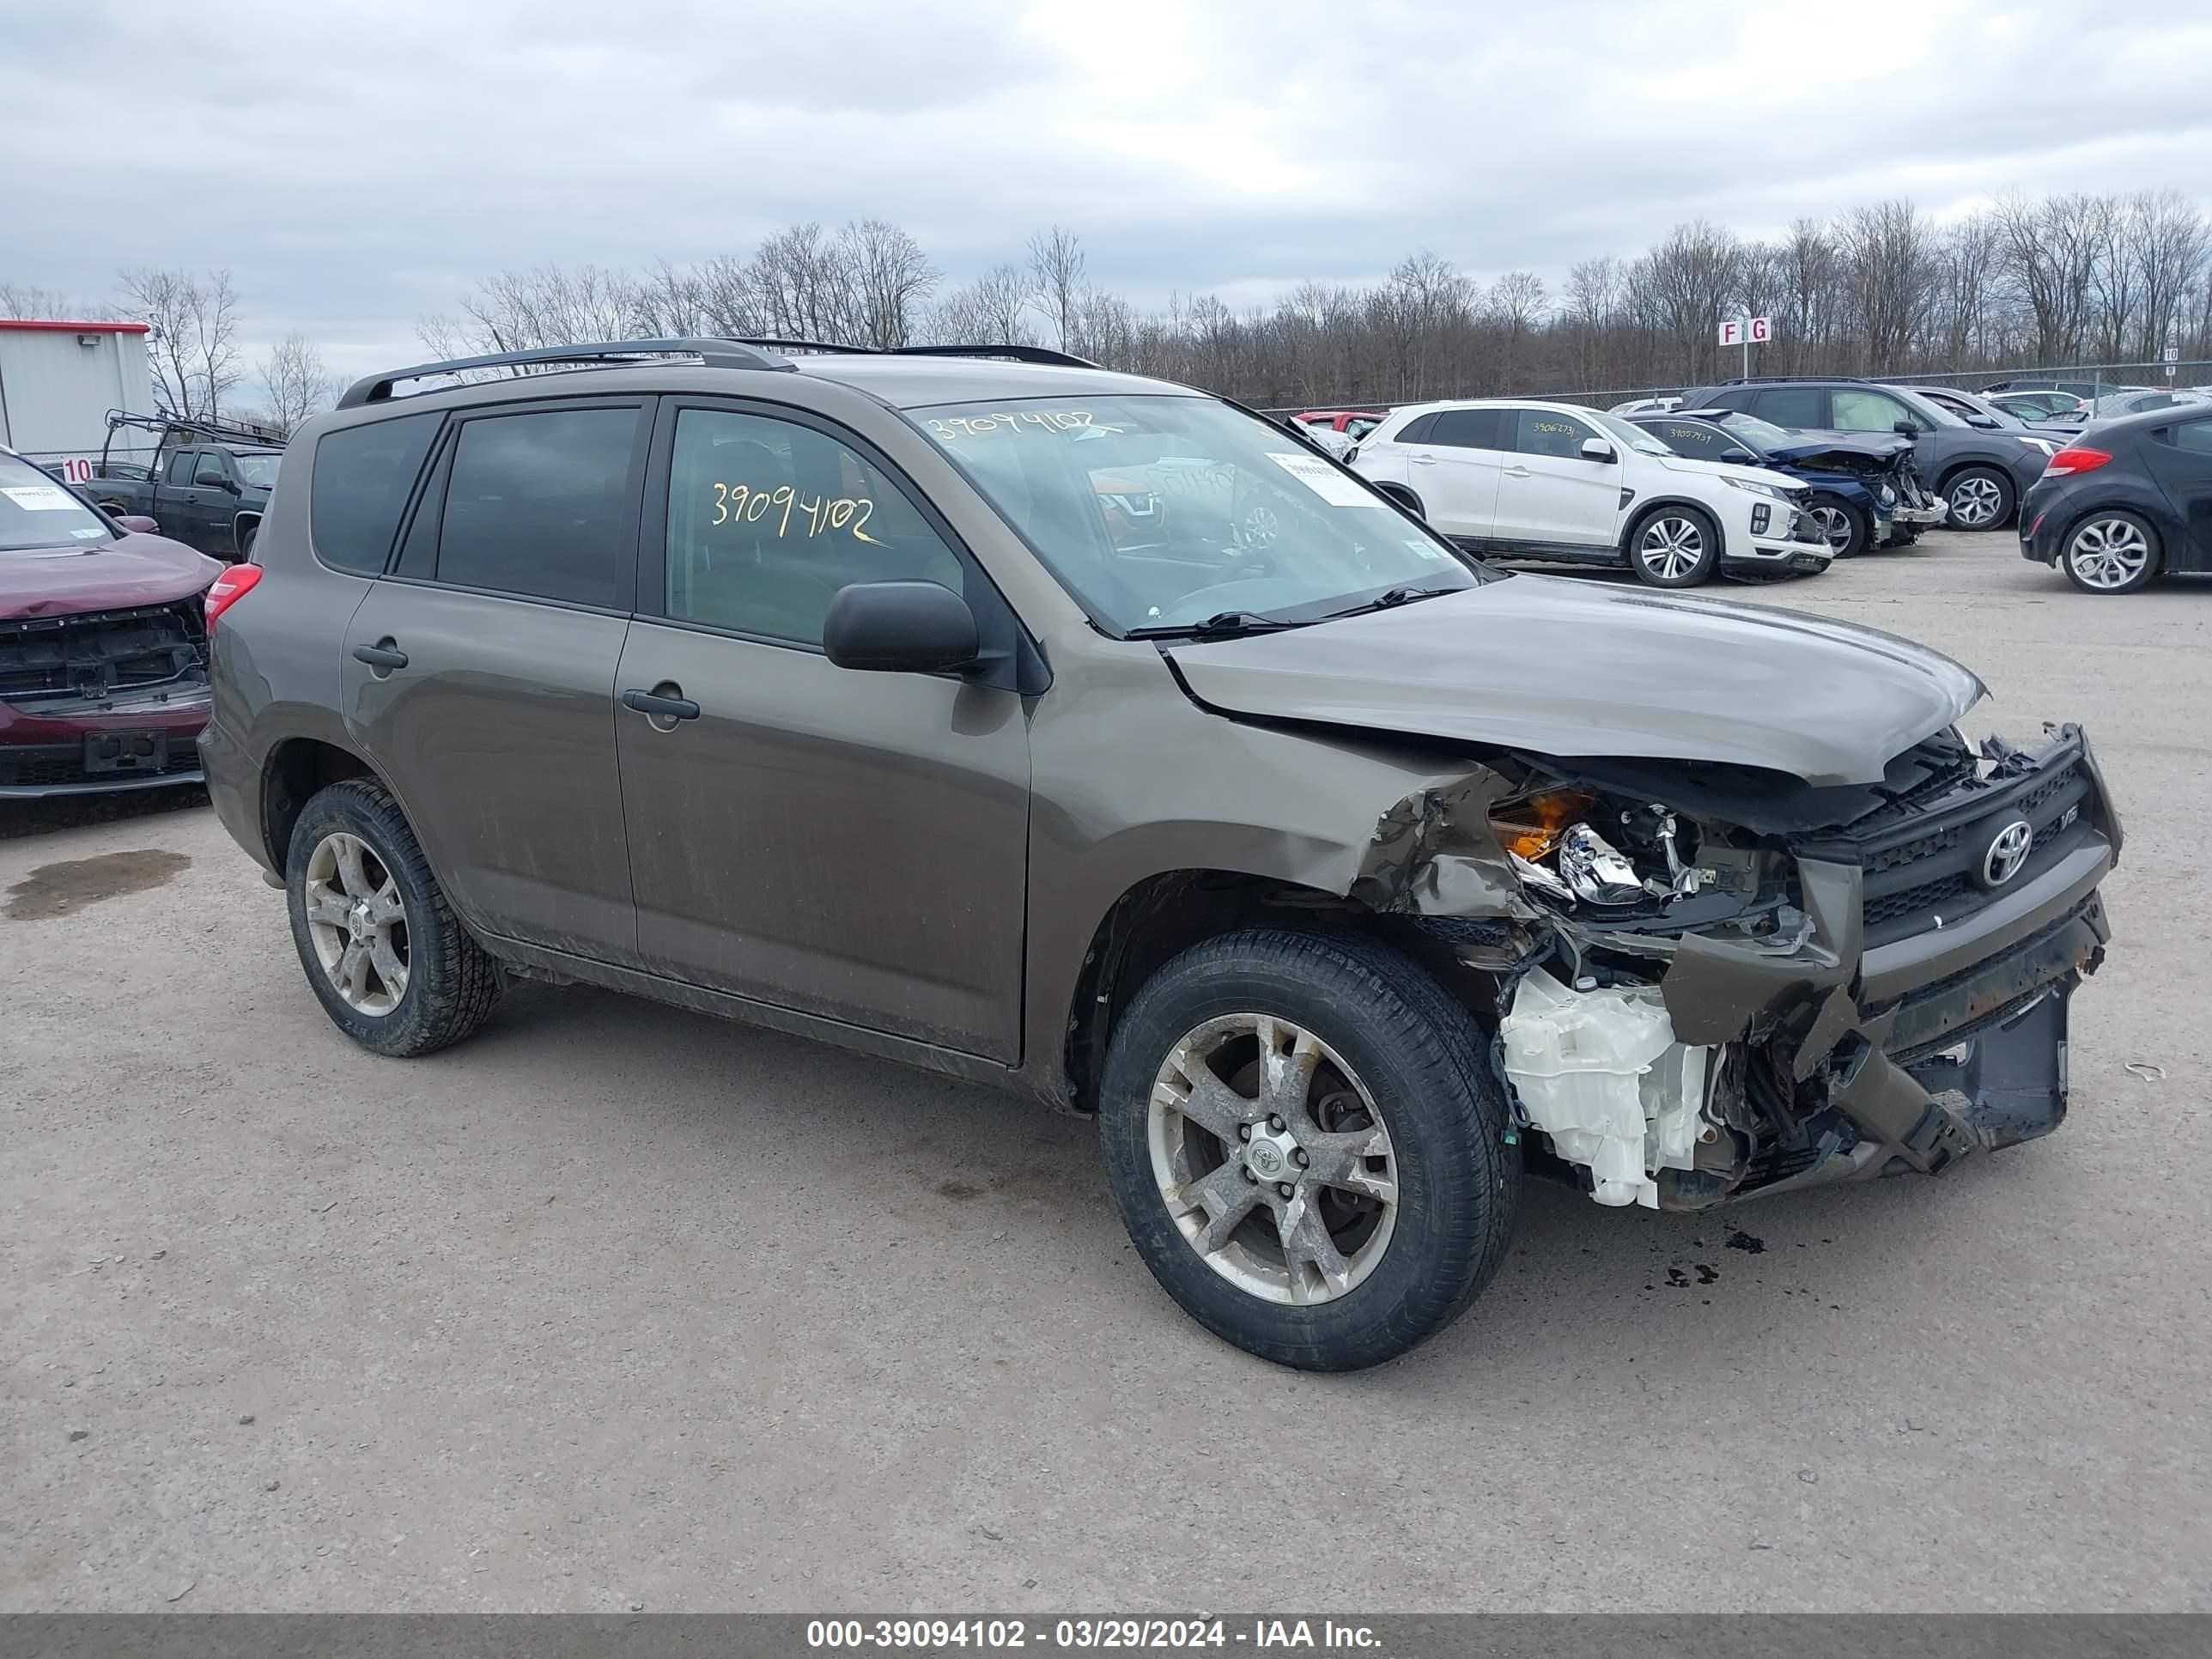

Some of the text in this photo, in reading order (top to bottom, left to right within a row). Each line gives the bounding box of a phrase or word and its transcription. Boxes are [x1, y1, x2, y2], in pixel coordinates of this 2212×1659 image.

[1725, 324, 1735, 343] F
[1753, 320, 1765, 339] G
[2166, 349, 2178, 359] 10
[928, 412, 1124, 440] 39094102
[64, 459, 91, 482] 10
[713, 483, 893, 549] 39094102
[2061, 805, 2078, 830] V6
